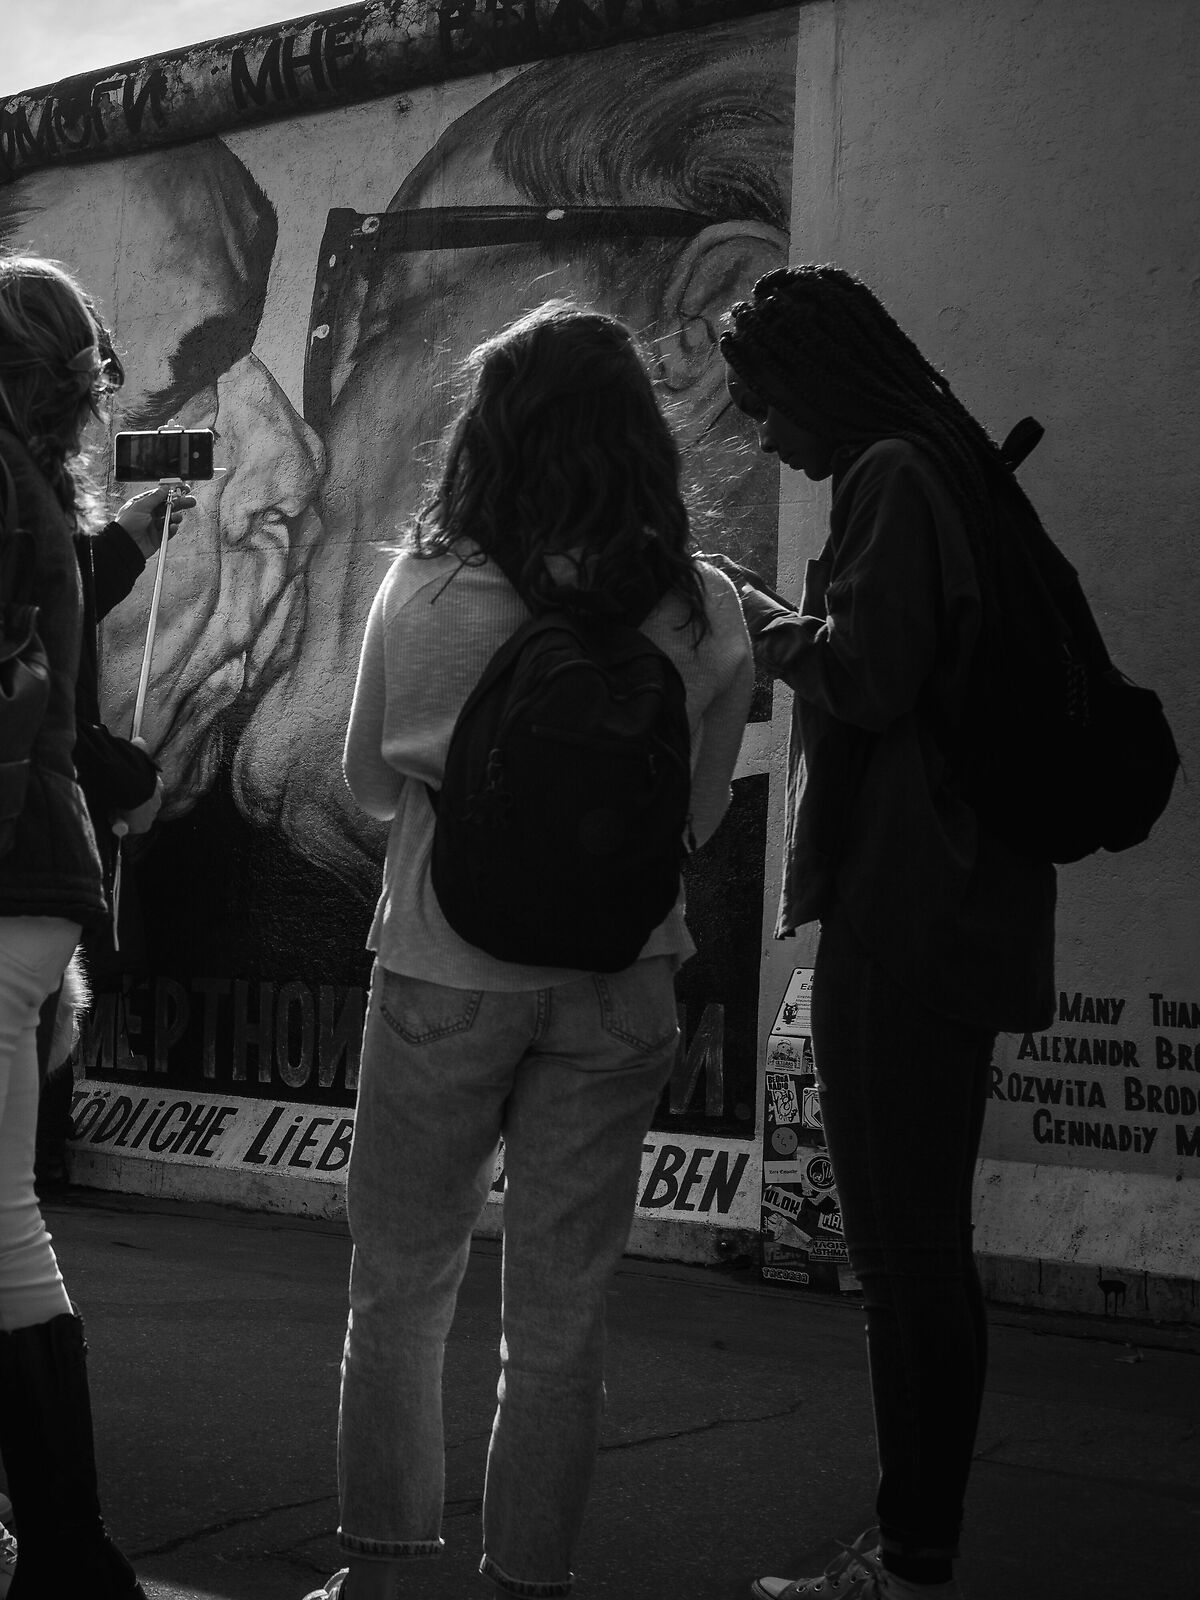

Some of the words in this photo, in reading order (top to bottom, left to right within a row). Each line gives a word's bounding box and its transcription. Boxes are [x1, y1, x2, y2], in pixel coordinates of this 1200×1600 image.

[231, 29, 355, 110] МНЕ
[1059, 991, 1126, 1025] MANY
[1017, 1032, 1140, 1068] ALEXANDR
[1124, 1076, 1200, 1116] BROD
